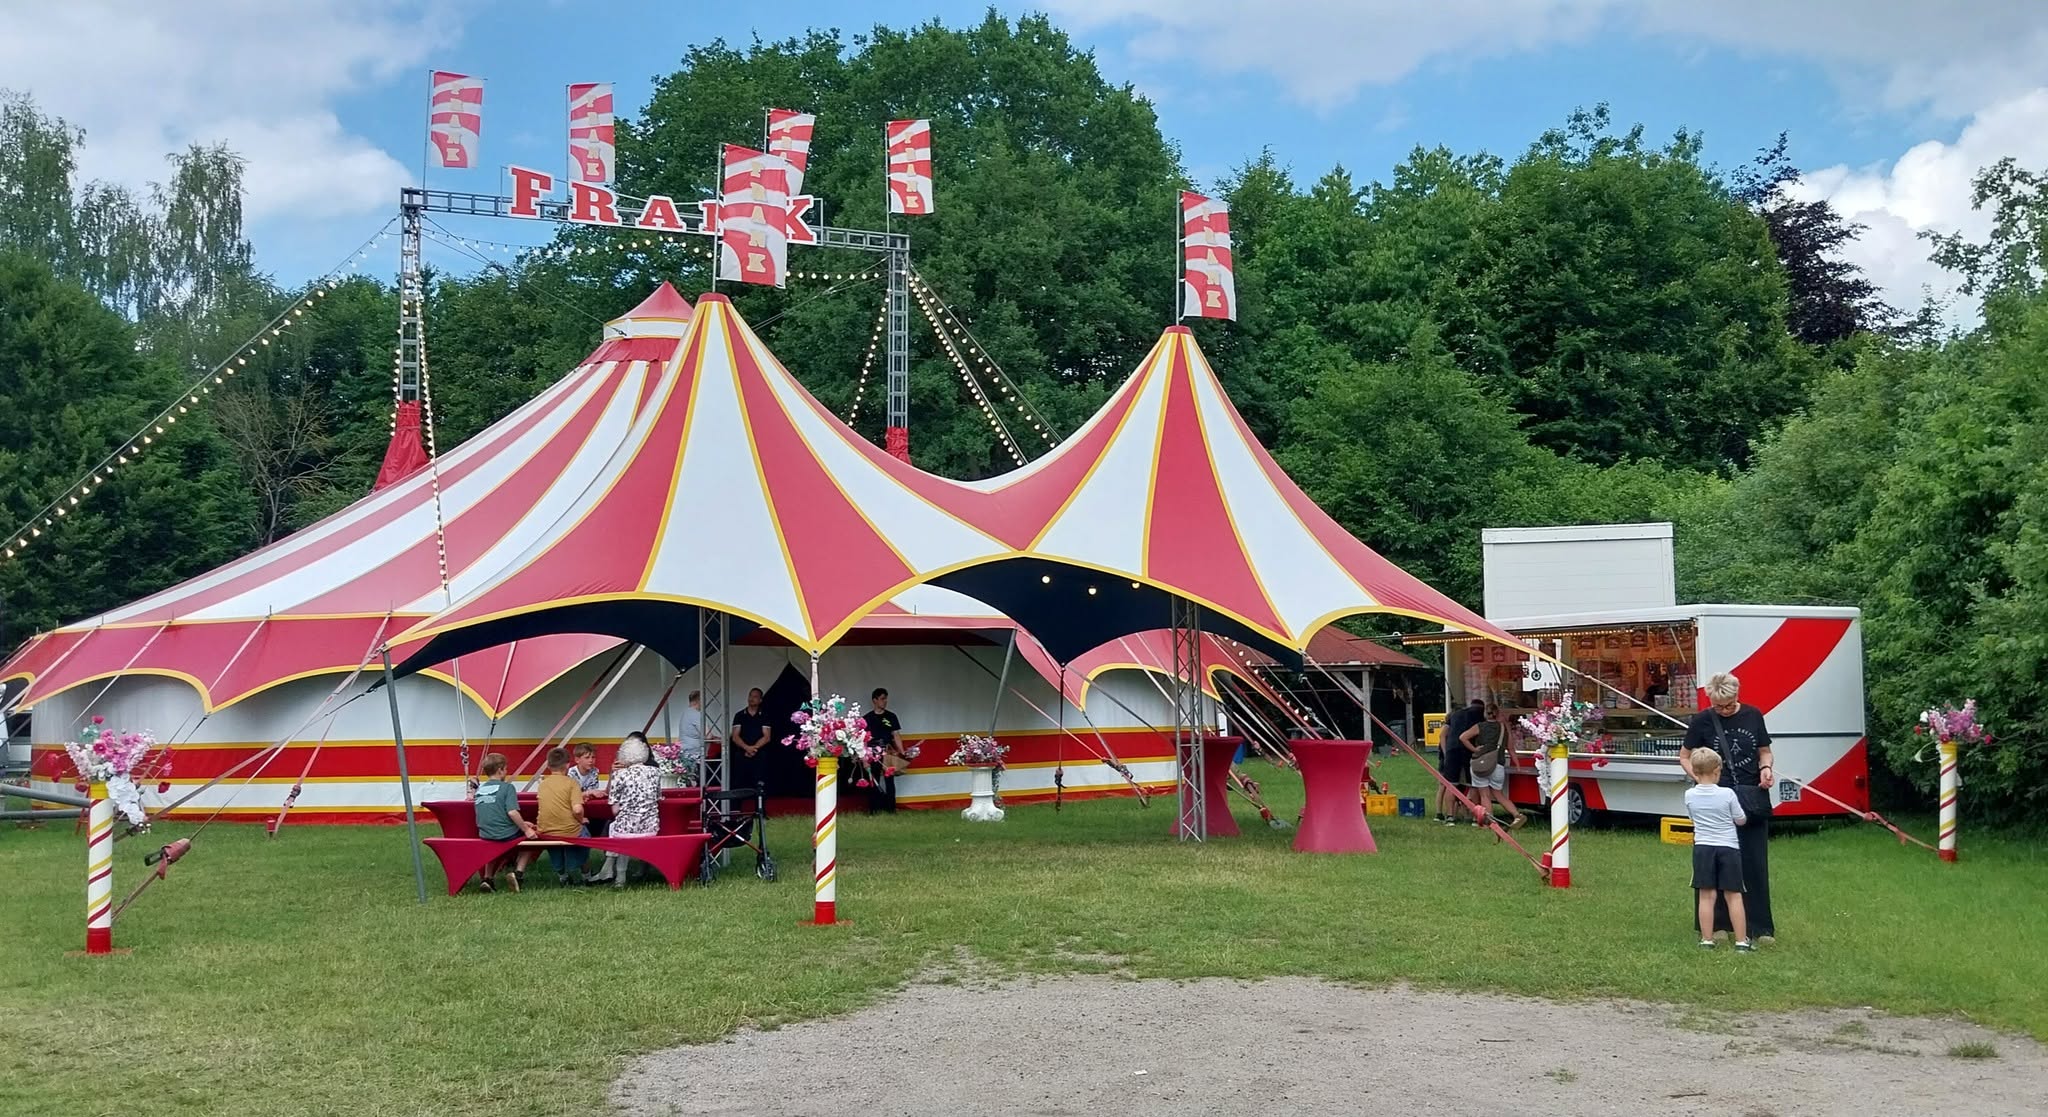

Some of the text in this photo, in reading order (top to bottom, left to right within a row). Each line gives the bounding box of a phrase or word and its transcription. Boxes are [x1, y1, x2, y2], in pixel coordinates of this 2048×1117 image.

[447, 82, 463, 161] FRANK
[586, 95, 600, 177] FRANK
[905, 132, 919, 208] FRANK
[747, 161, 767, 273] FRANK
[1202, 207, 1222, 308] FRANK
